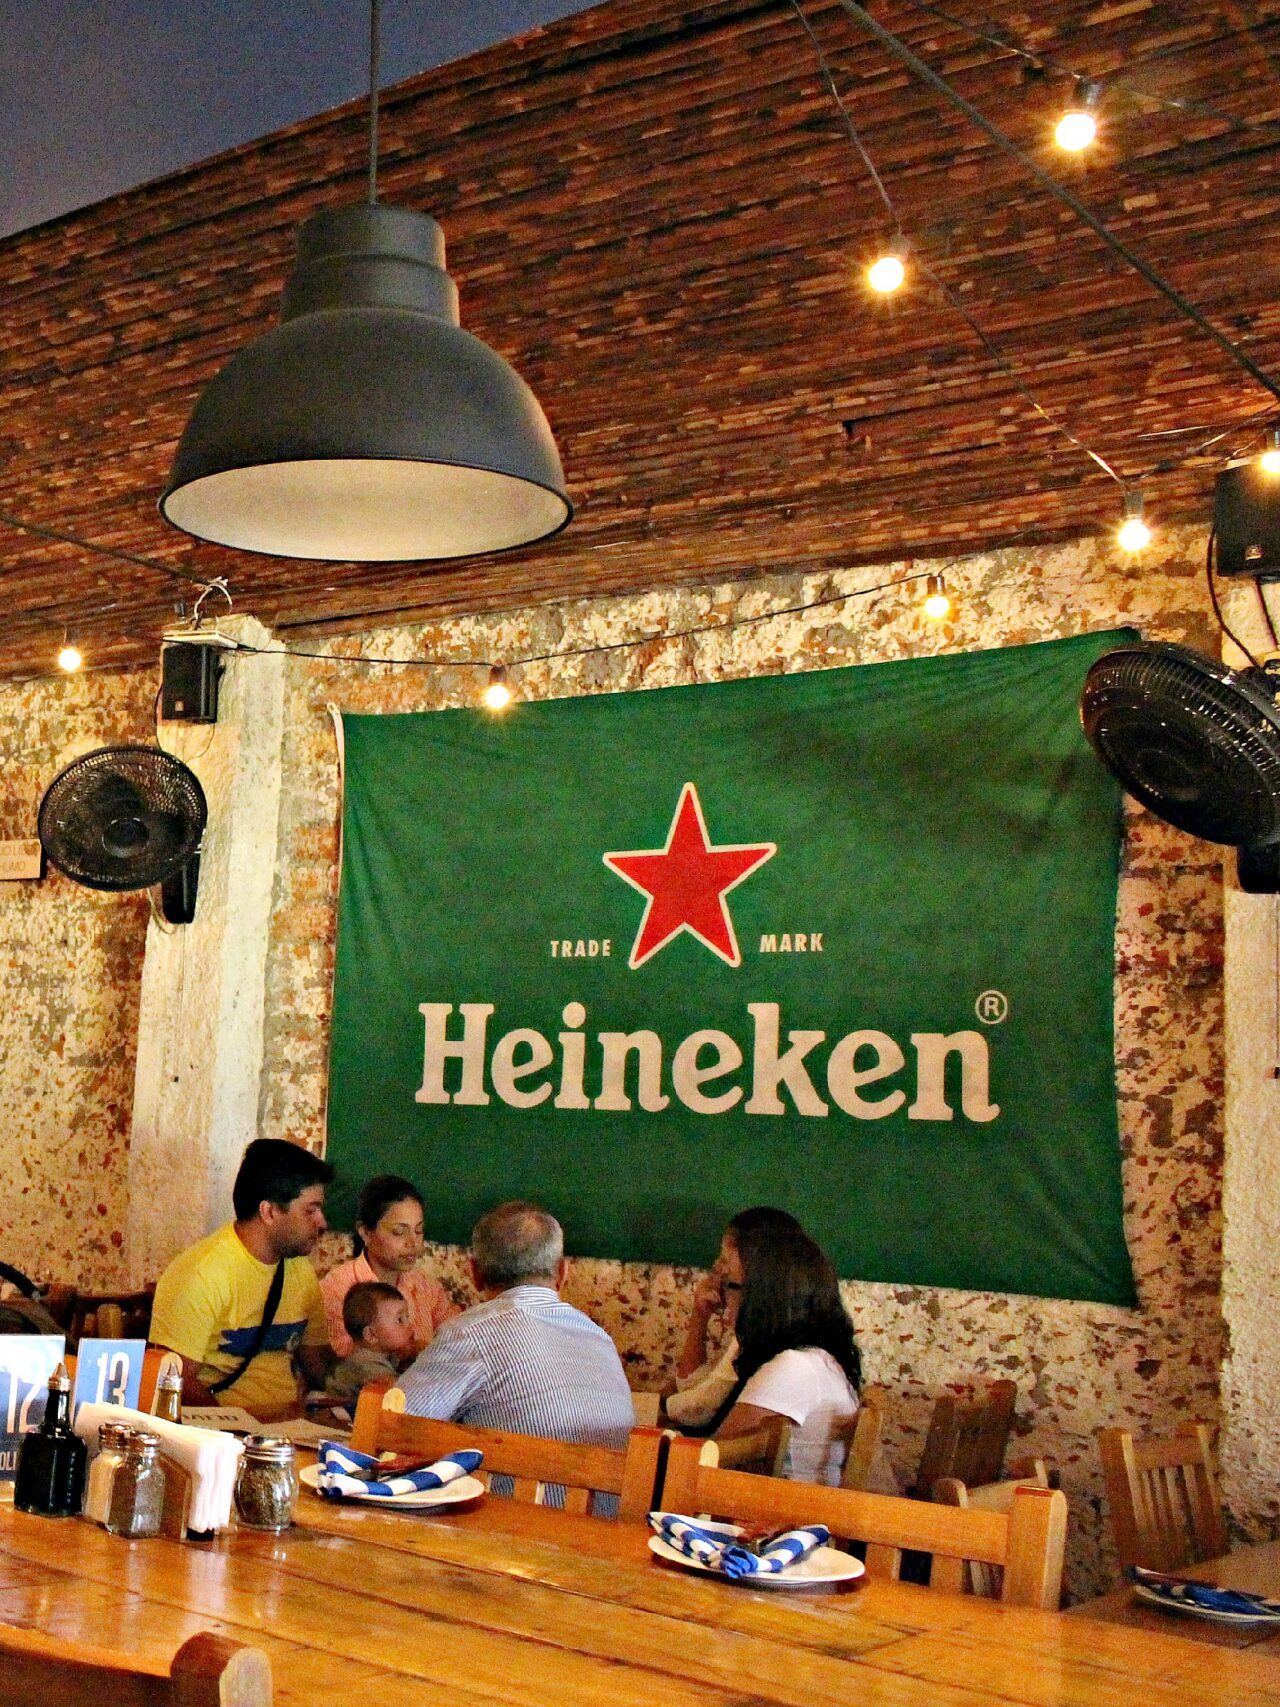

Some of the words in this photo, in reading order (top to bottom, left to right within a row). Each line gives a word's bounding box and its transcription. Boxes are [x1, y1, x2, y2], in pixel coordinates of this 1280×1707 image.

[550, 939, 612, 958] TRADE
[759, 932, 823, 953] MARK
[414, 1001, 1001, 1123] Heineken
[3, 1350, 47, 1434] 12
[95, 1351, 130, 1407] 13
